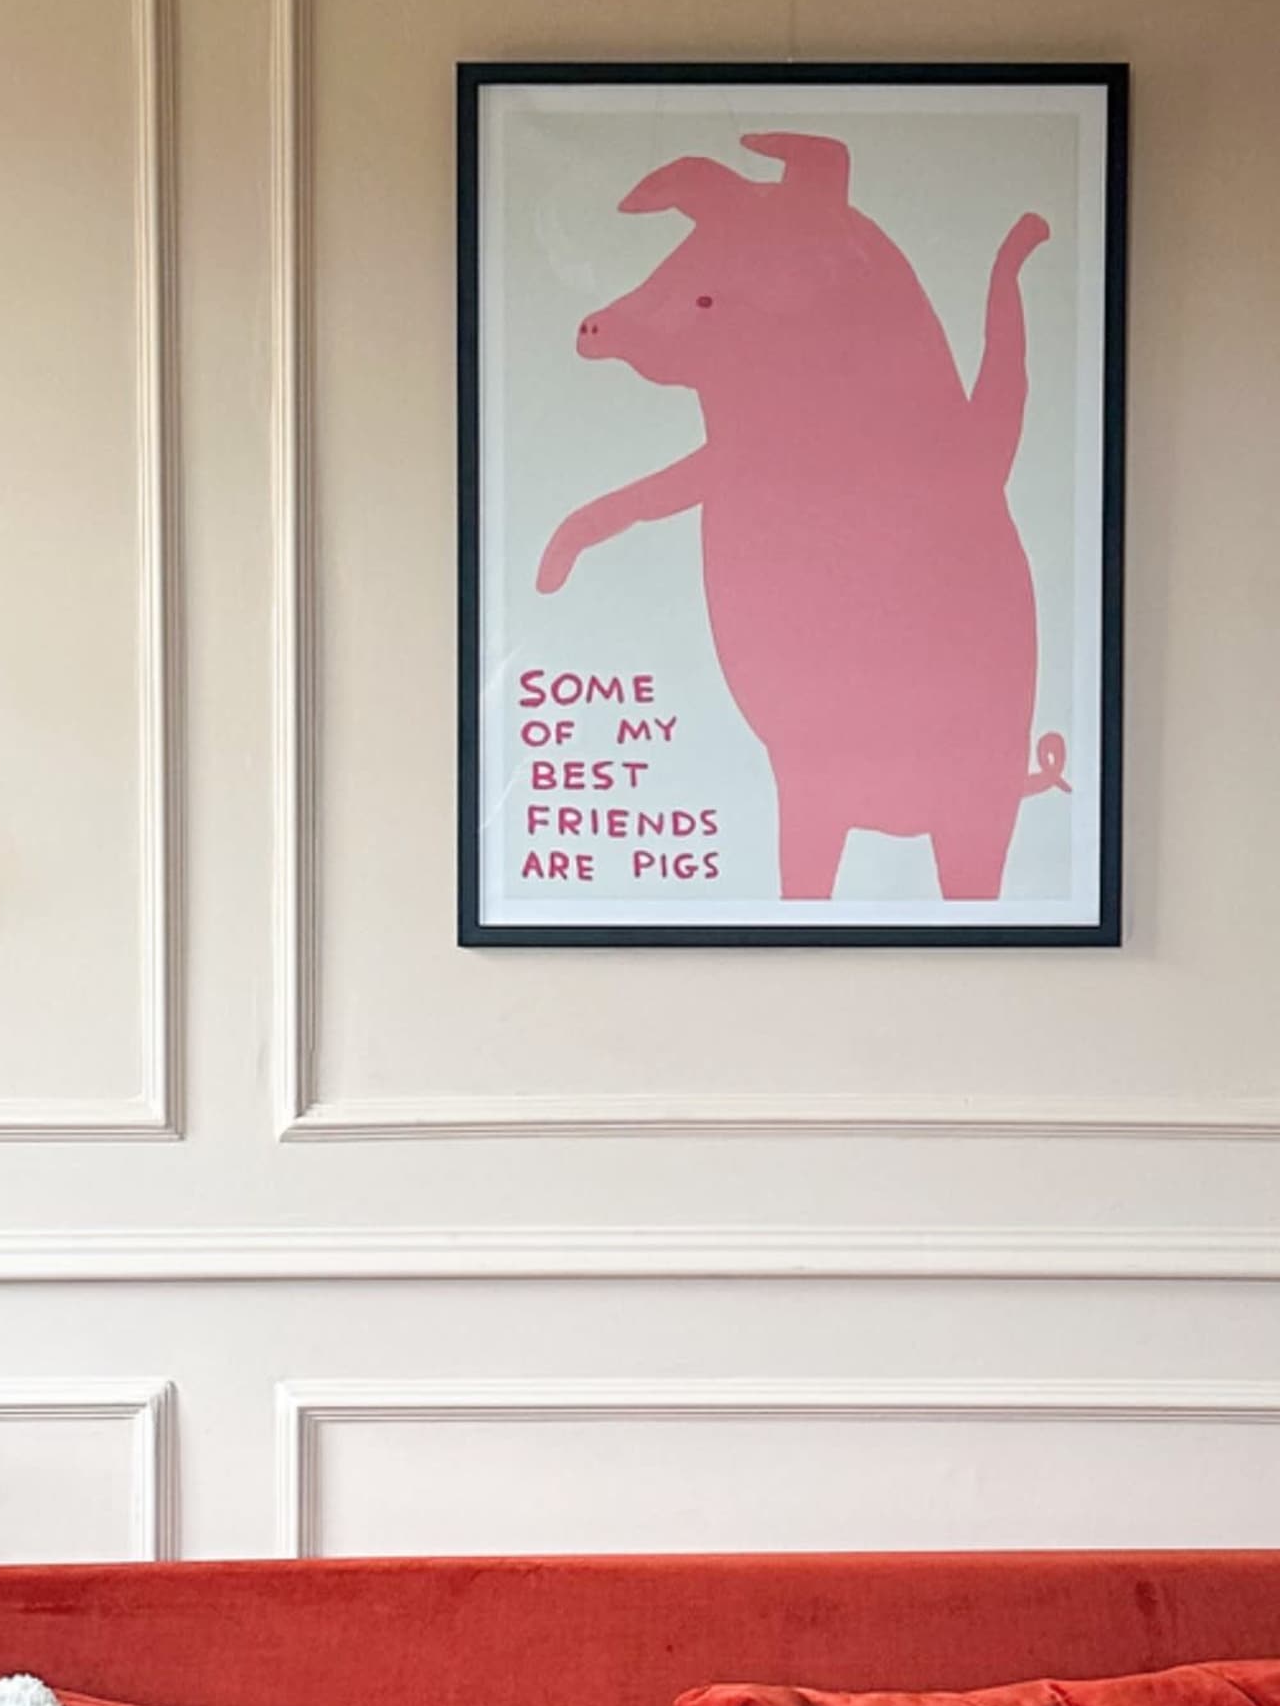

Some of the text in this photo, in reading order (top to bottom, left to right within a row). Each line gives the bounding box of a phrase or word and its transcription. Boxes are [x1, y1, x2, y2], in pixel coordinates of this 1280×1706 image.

[518, 669, 655, 708] SOME
[521, 715, 677, 747] OF MY
[531, 760, 649, 790] BEST
[527, 804, 719, 838] FRIENDS
[521, 849, 719, 881] ARE PIGS
